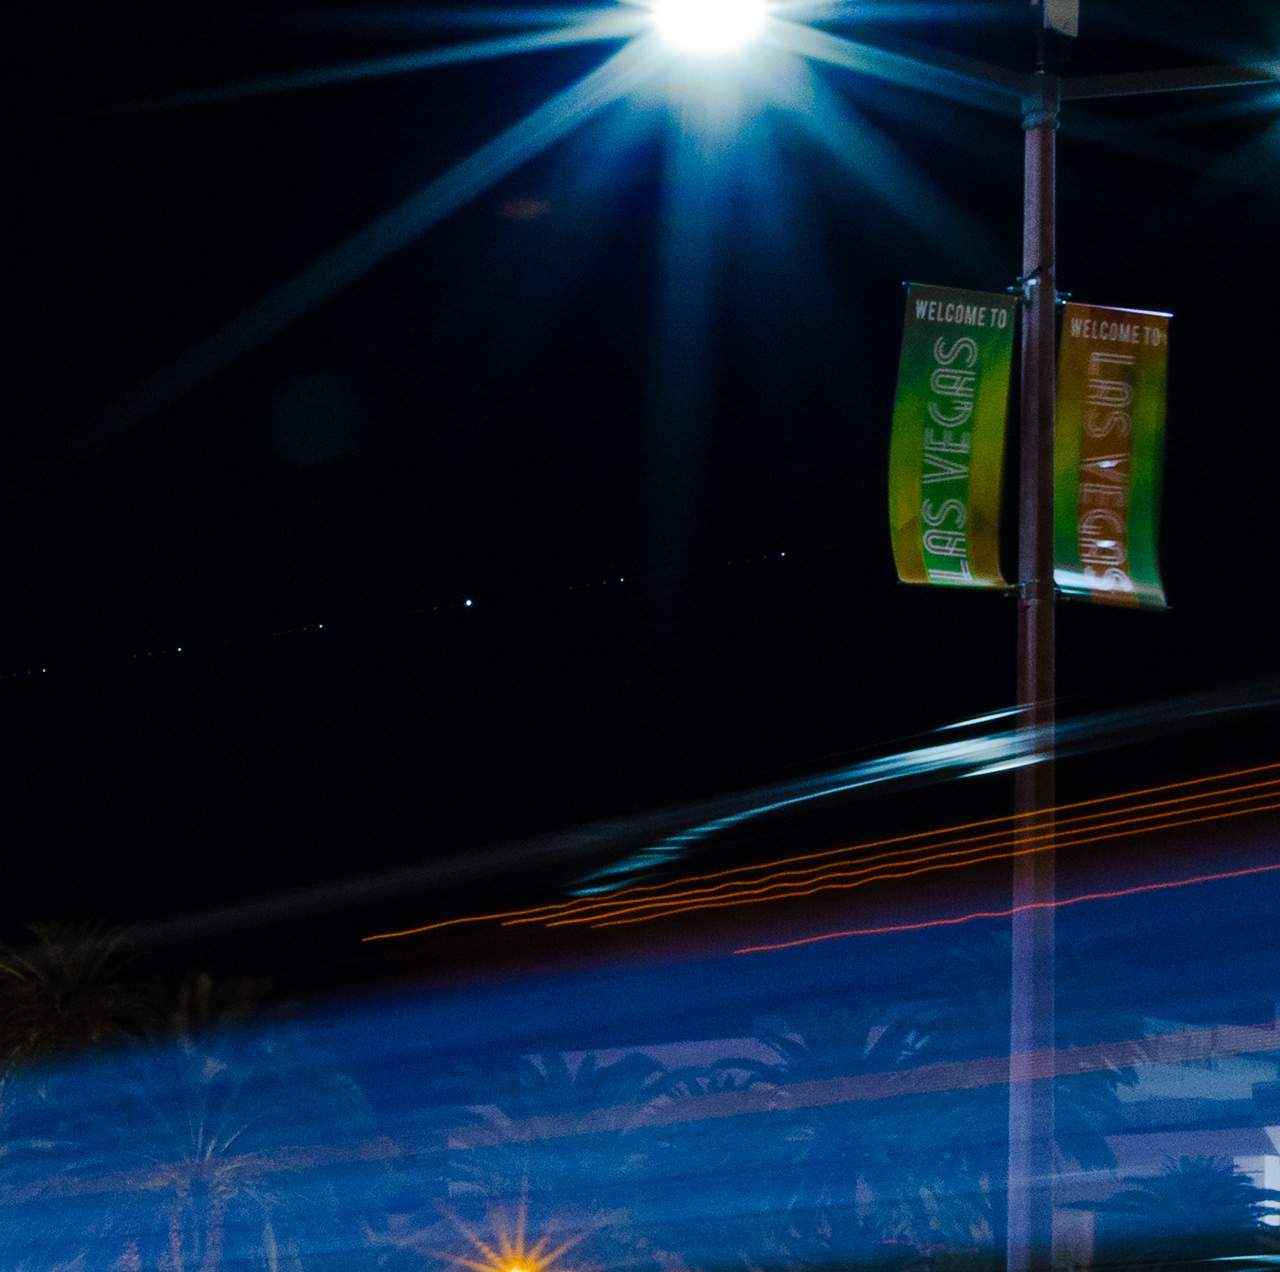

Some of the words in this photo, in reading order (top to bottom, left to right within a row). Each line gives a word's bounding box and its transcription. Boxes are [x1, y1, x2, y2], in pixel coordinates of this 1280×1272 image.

[916, 300, 986, 327] WELCOME
[991, 308, 1007, 328] TO
[1071, 317, 1139, 344] WELCOME
[1144, 326, 1161, 347] TO
[921, 336, 979, 485] VEGAS
[1084, 351, 1136, 438] LAS
[921, 498, 975, 588] LAS
